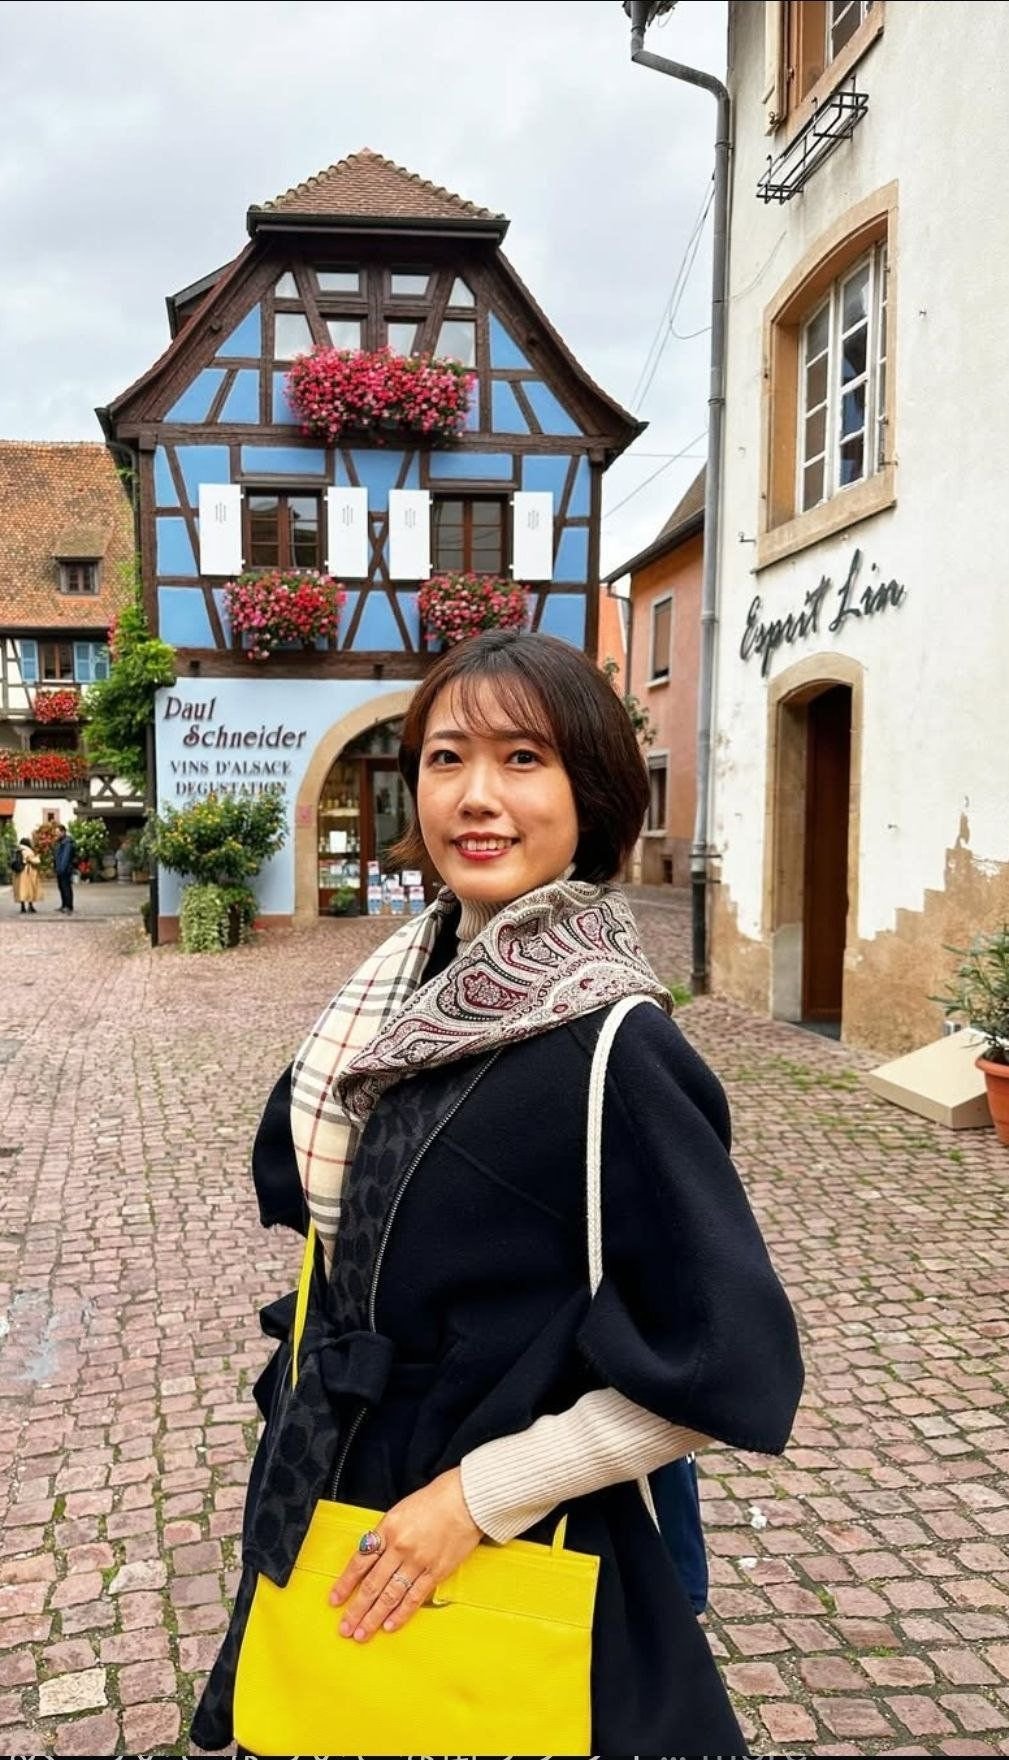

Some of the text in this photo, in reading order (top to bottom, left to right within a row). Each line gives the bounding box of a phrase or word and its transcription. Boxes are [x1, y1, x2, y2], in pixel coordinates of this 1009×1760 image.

[740, 548, 905, 678] Esprit Lin
[183, 724, 307, 749] Schneider
[170, 760, 292, 776] VINS D'ALSACE
